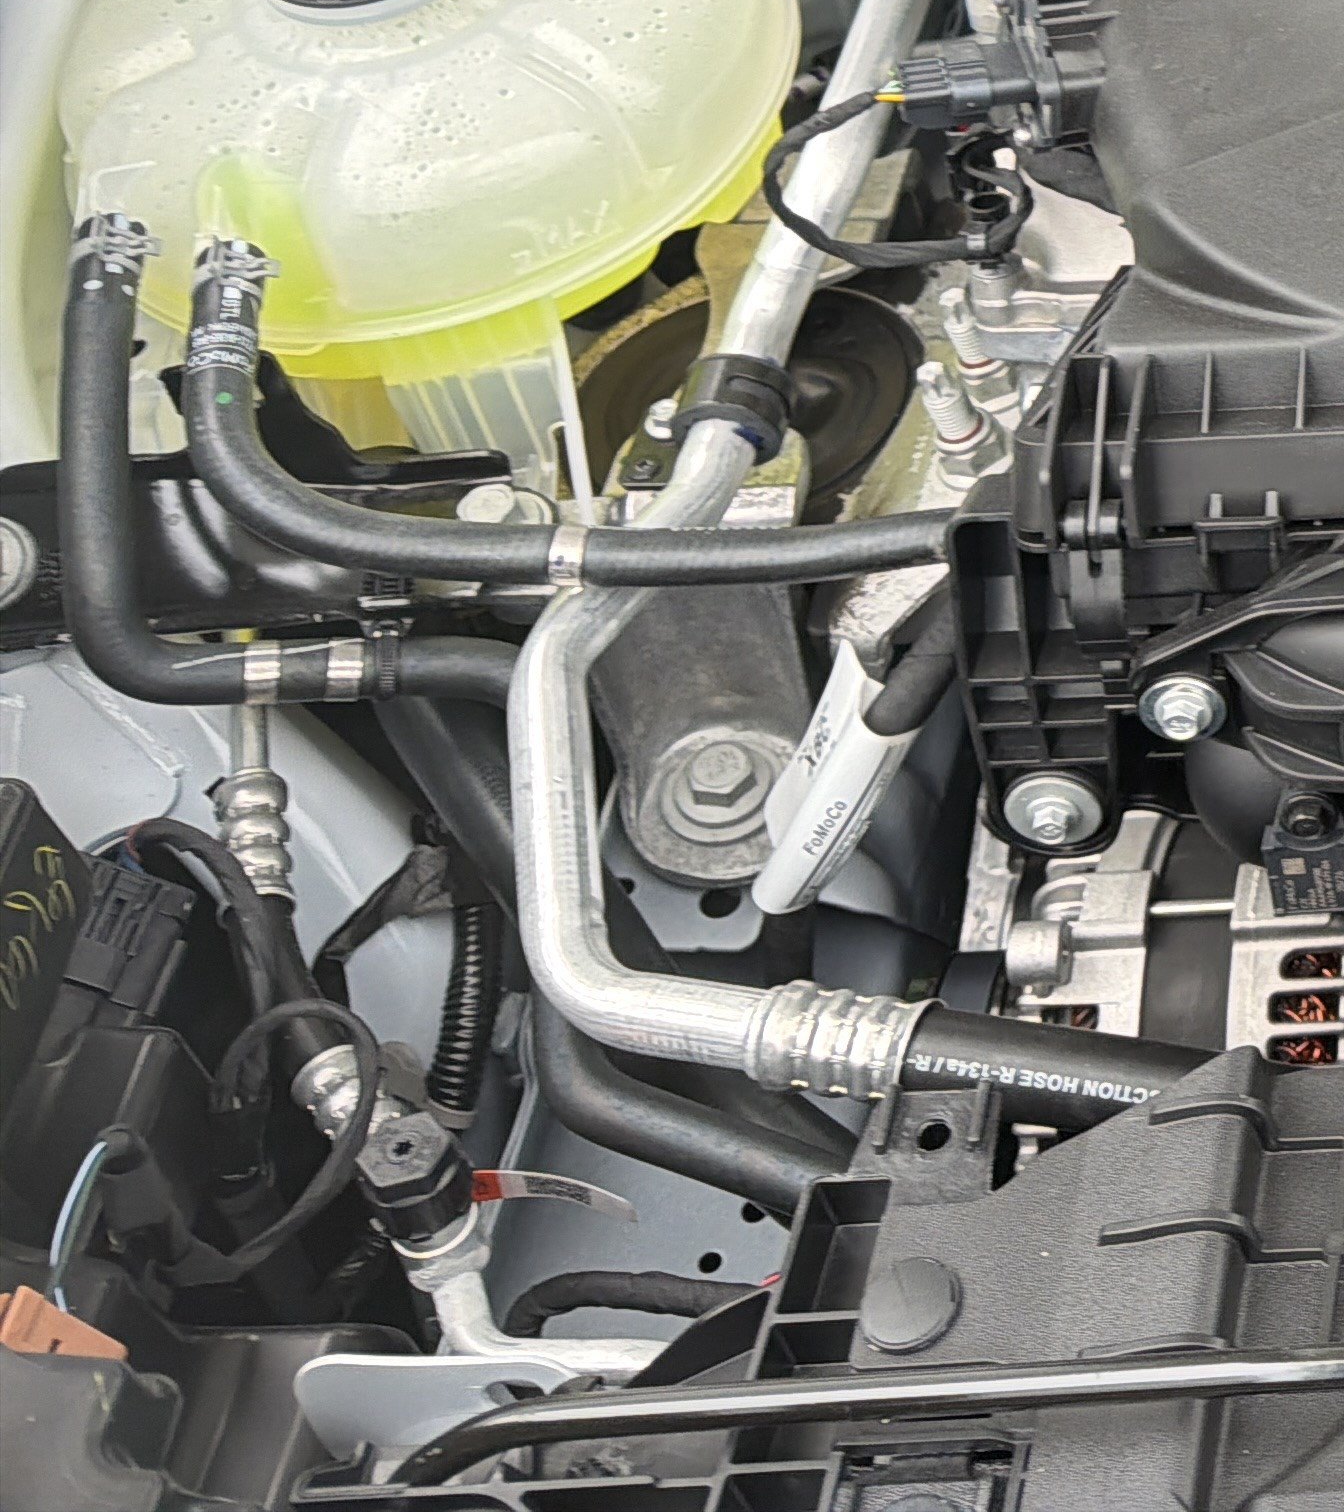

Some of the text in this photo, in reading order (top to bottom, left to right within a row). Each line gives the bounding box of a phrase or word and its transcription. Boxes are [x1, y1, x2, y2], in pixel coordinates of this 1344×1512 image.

[802, 799, 848, 858] FoMoCo
[946, 1062, 1016, 1085] R-134a
[1017, 1069, 1080, 1094] HOSE
